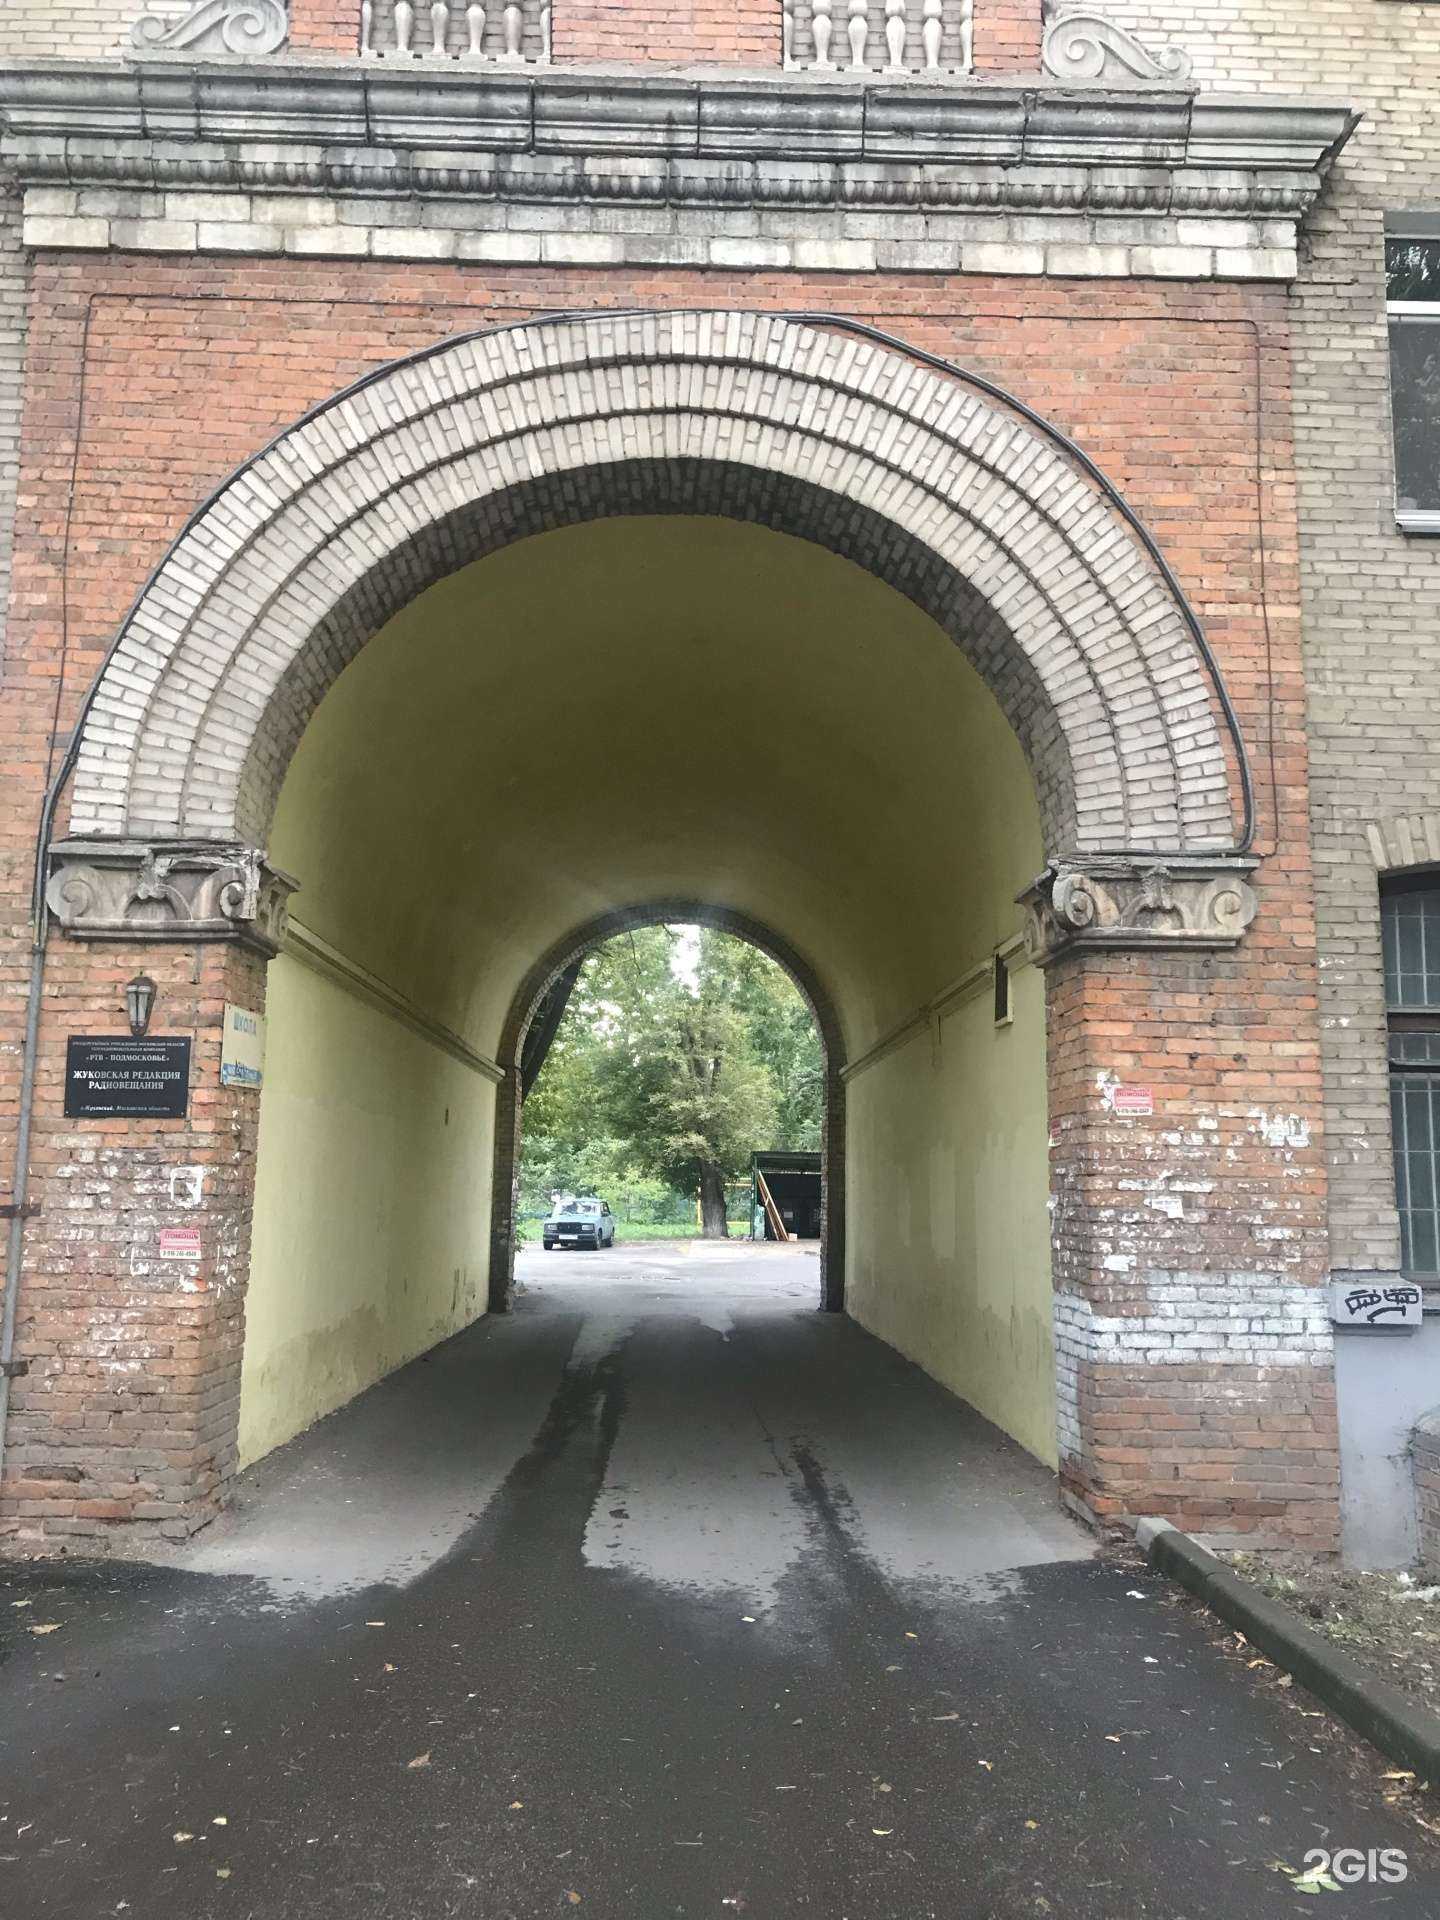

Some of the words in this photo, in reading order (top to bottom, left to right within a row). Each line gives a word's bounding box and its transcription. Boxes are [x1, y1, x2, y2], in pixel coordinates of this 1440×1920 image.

[72, 1070, 130, 1079] ЖУКОВСКАЯ
[132, 1071, 181, 1080] РЕДАКЦИЯ
[88, 1081, 165, 1090] РАДИОВЕЩАНИЯ
